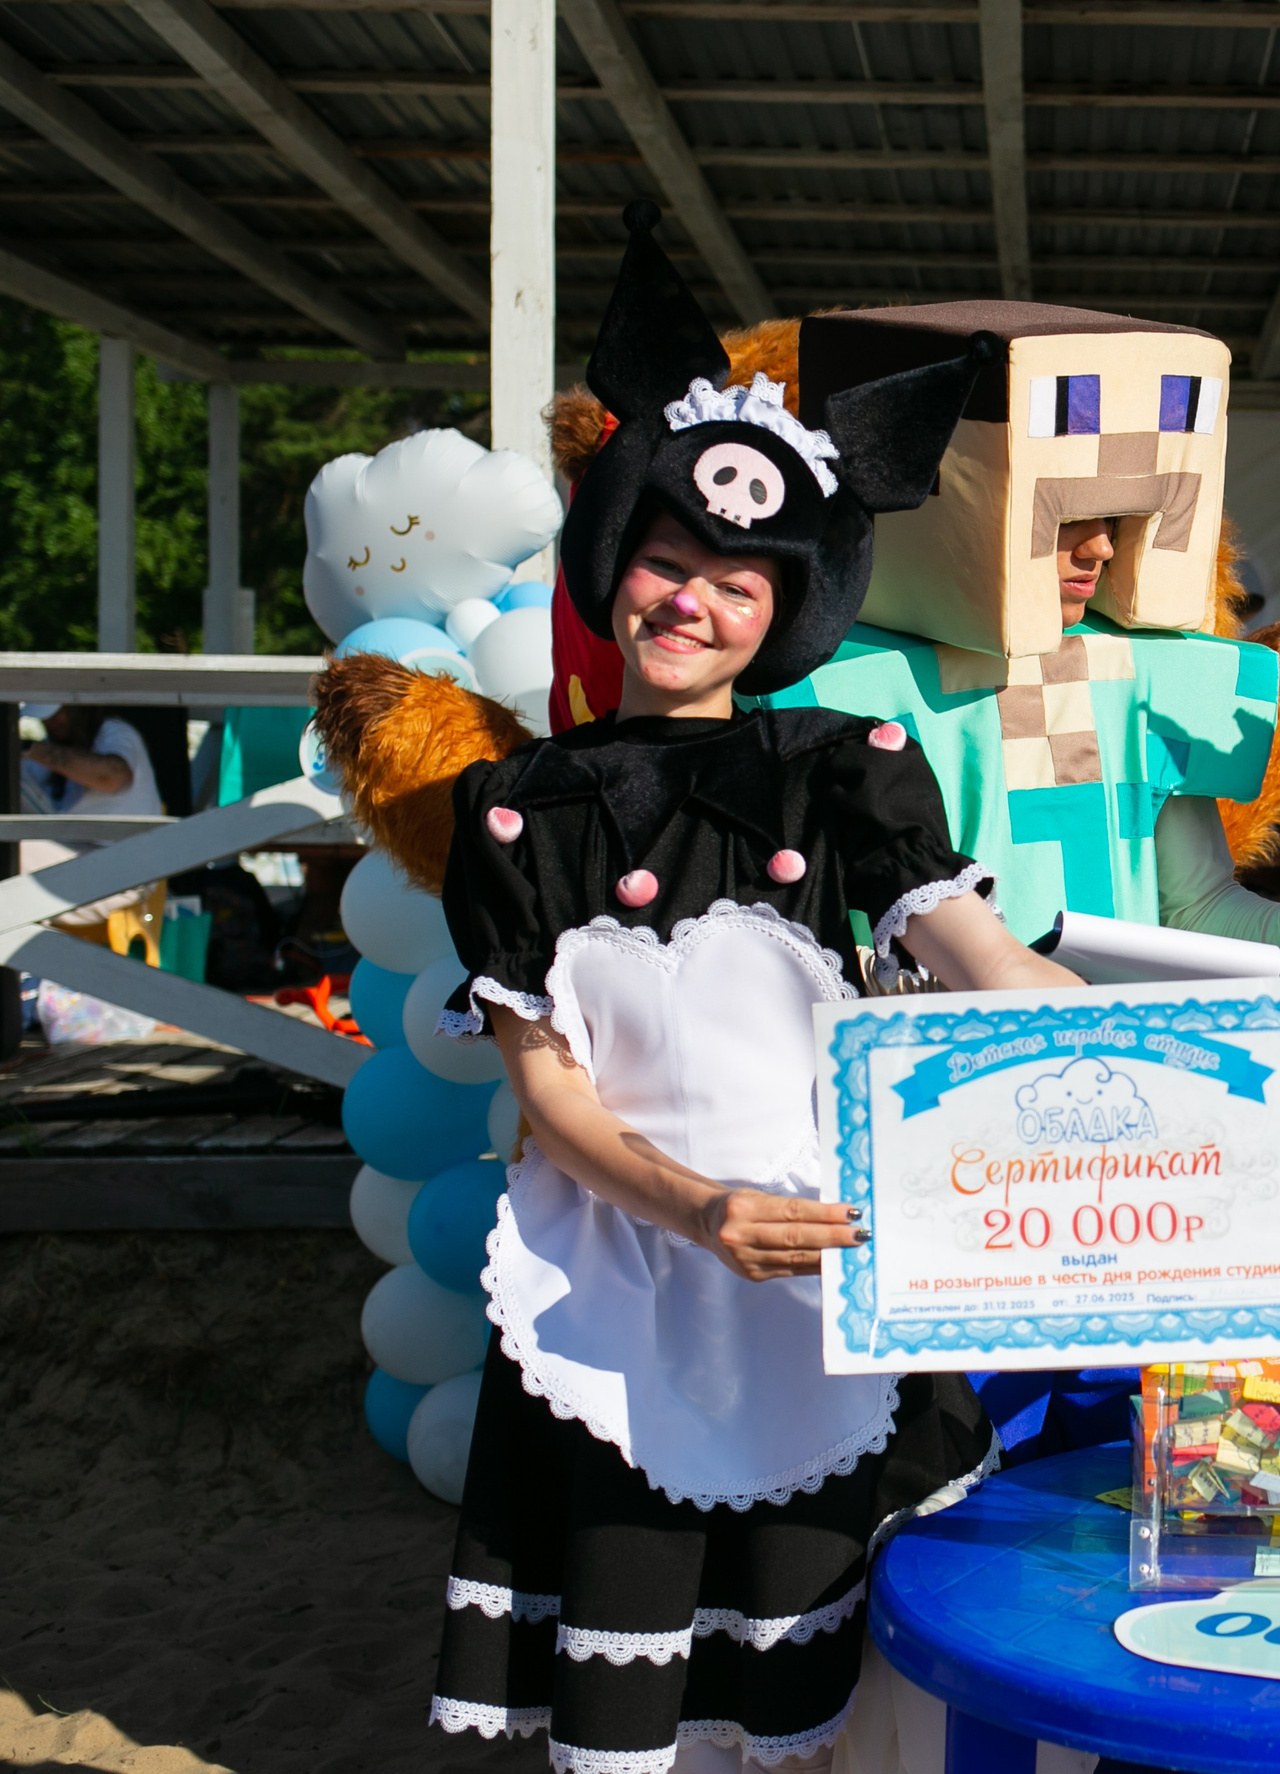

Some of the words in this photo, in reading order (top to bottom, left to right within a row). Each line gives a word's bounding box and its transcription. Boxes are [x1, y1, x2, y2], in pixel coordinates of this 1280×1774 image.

[947, 1034, 1048, 1083] Детская
[1053, 1019, 1138, 1058] игровая
[1144, 1033, 1221, 1070] студия
[1016, 1106, 1158, 1144] ОБЛАКА
[951, 1143, 1223, 1208] Сертификат
[983, 1207, 1051, 1250] 20
[909, 1279, 929, 1291] на
[934, 1273, 1032, 1293] розыгрыше
[1037, 1275, 1047, 1285] в
[1052, 1270, 1098, 1285] честь
[1103, 1270, 1132, 1286] дня
[1137, 1265, 1222, 1283] рождения
[1062, 1253, 1118, 1268] выдан
[888, 1304, 961, 1315] действителен
[964, 1303, 979, 1313] до:
[1146, 1292, 1197, 1304] Подпись:
